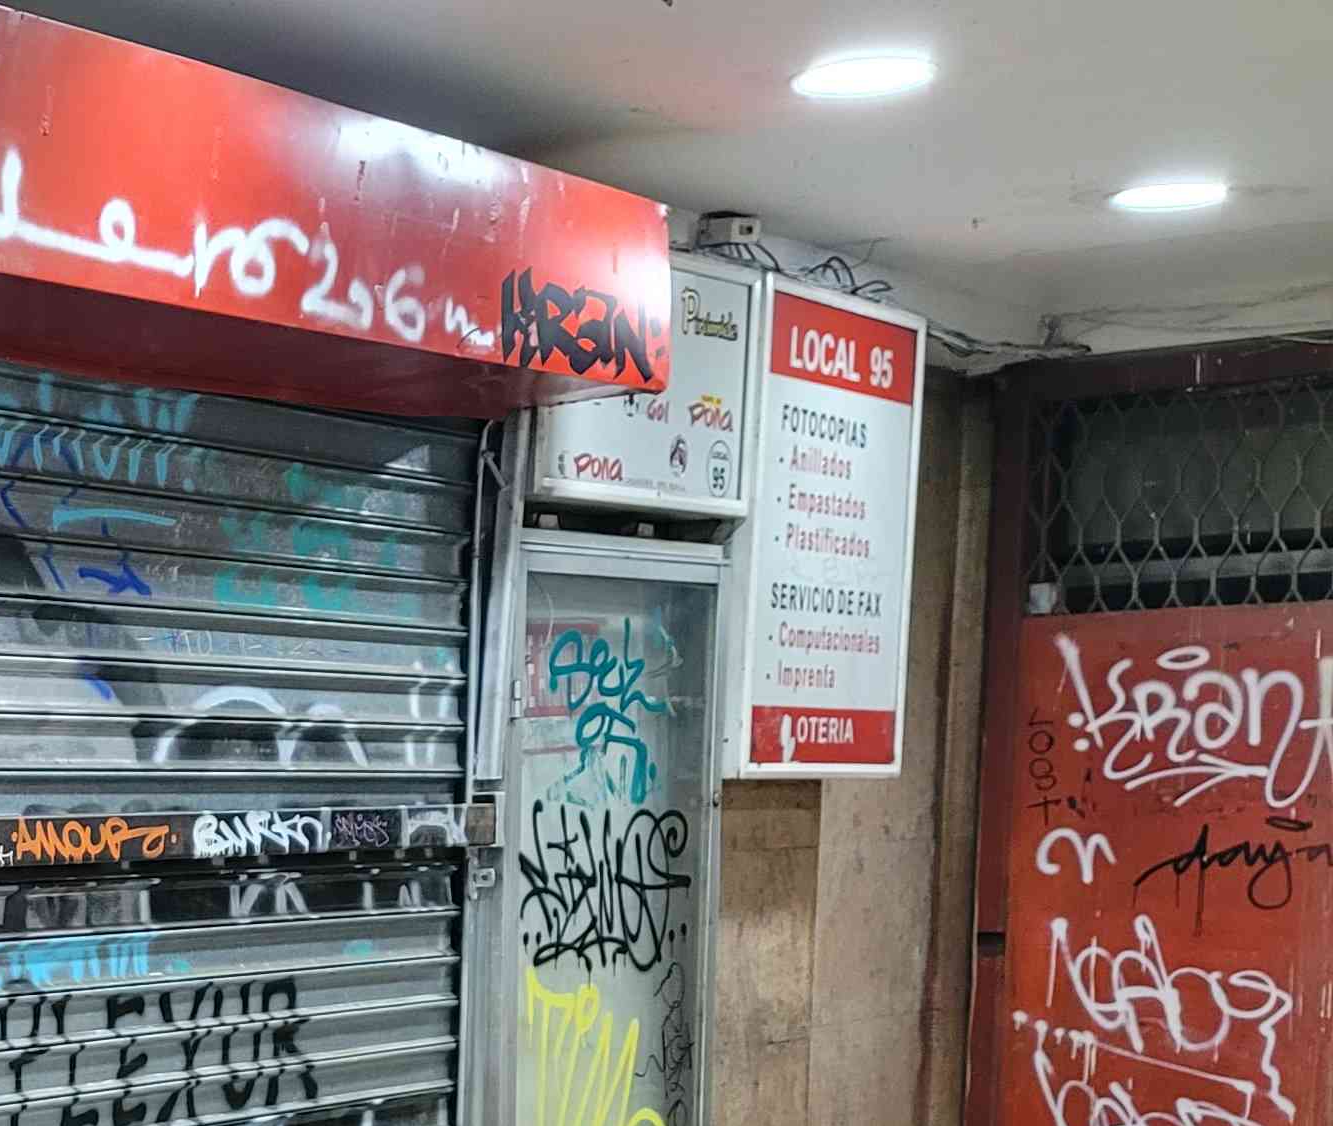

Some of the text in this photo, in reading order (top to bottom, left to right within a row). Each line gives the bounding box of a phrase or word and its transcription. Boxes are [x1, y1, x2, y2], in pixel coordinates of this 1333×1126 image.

[789, 324, 894, 389] LOCAL 95
[781, 403, 868, 449] FOTOCOPIAS
[789, 445, 853, 481] Anillados
[788, 482, 866, 521] Empastados
[784, 522, 871, 560] Plastificados
[770, 582, 882, 617] SERVICIO DE FAX
[779, 620, 881, 656] Computacionales
[777, 659, 837, 693] Imprenta
